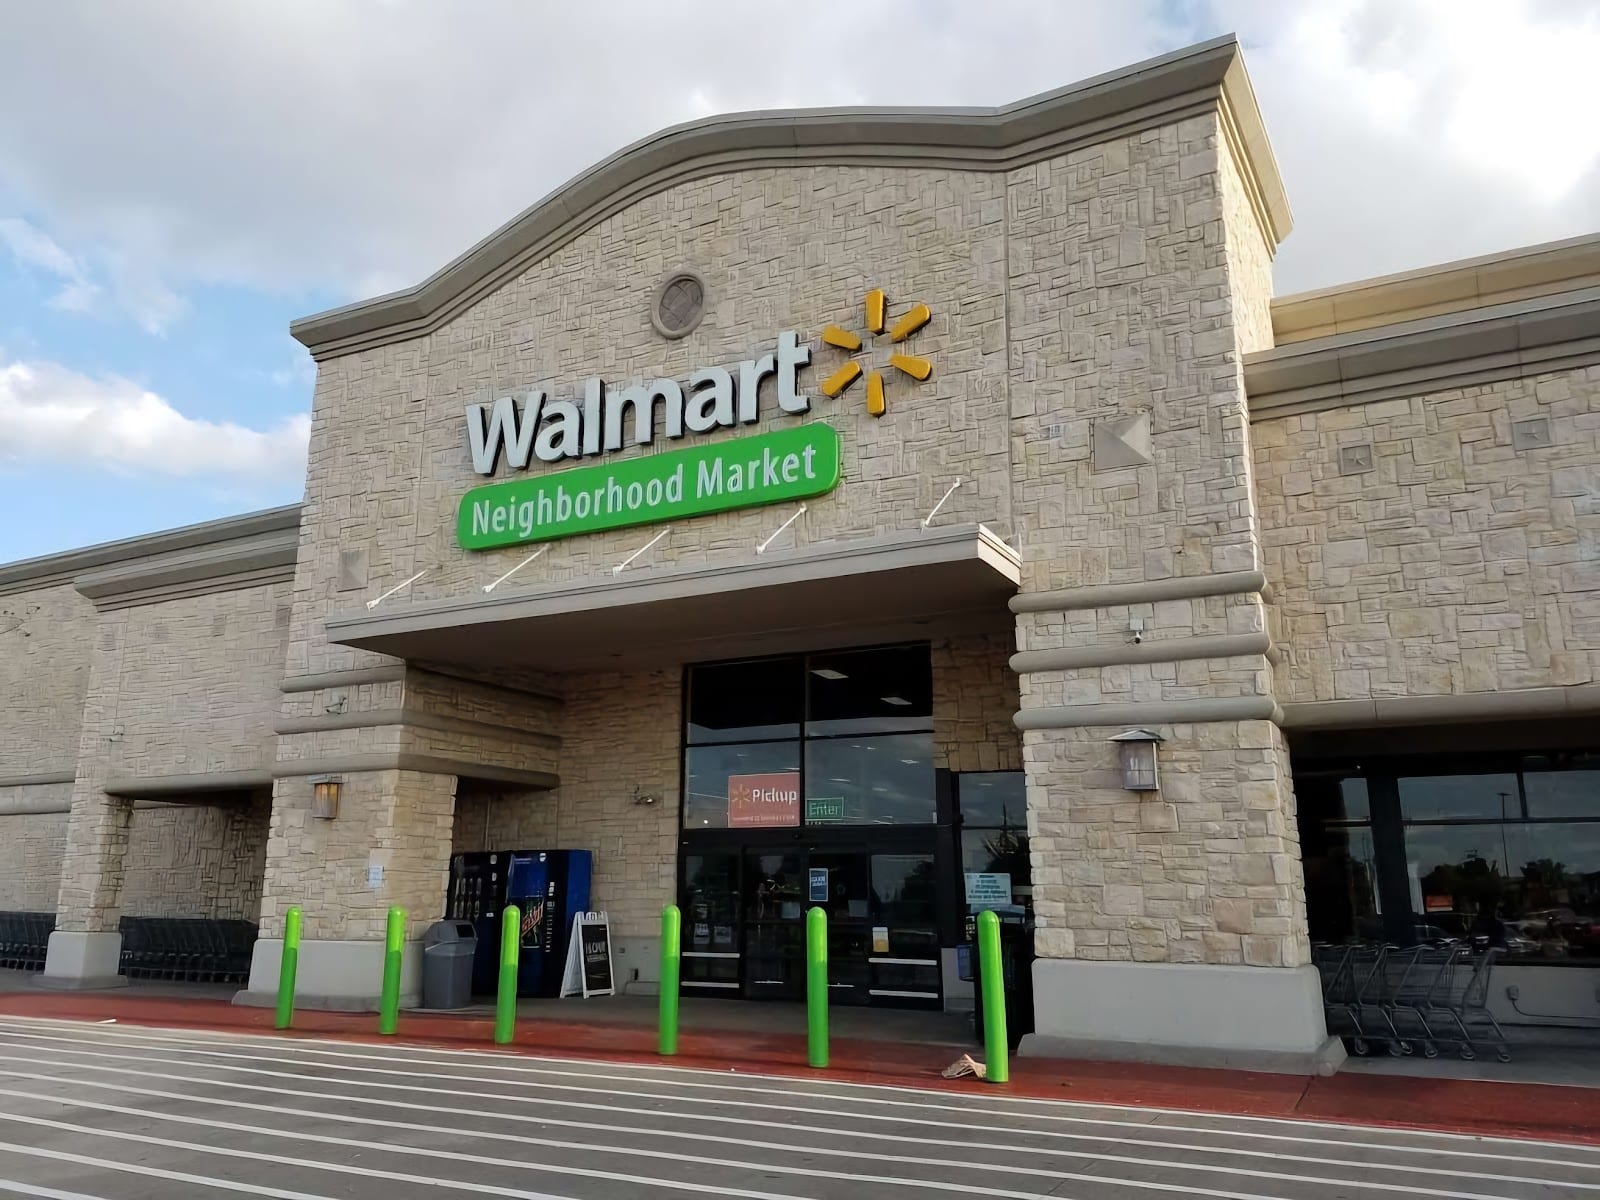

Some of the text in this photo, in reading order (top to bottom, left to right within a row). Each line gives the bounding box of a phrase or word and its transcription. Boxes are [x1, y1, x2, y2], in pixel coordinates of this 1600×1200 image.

[465, 330, 811, 476] Walmart
[471, 443, 817, 538] Neighborhood Market
[752, 787, 798, 806] Pickup
[809, 802, 840, 816] Enter
